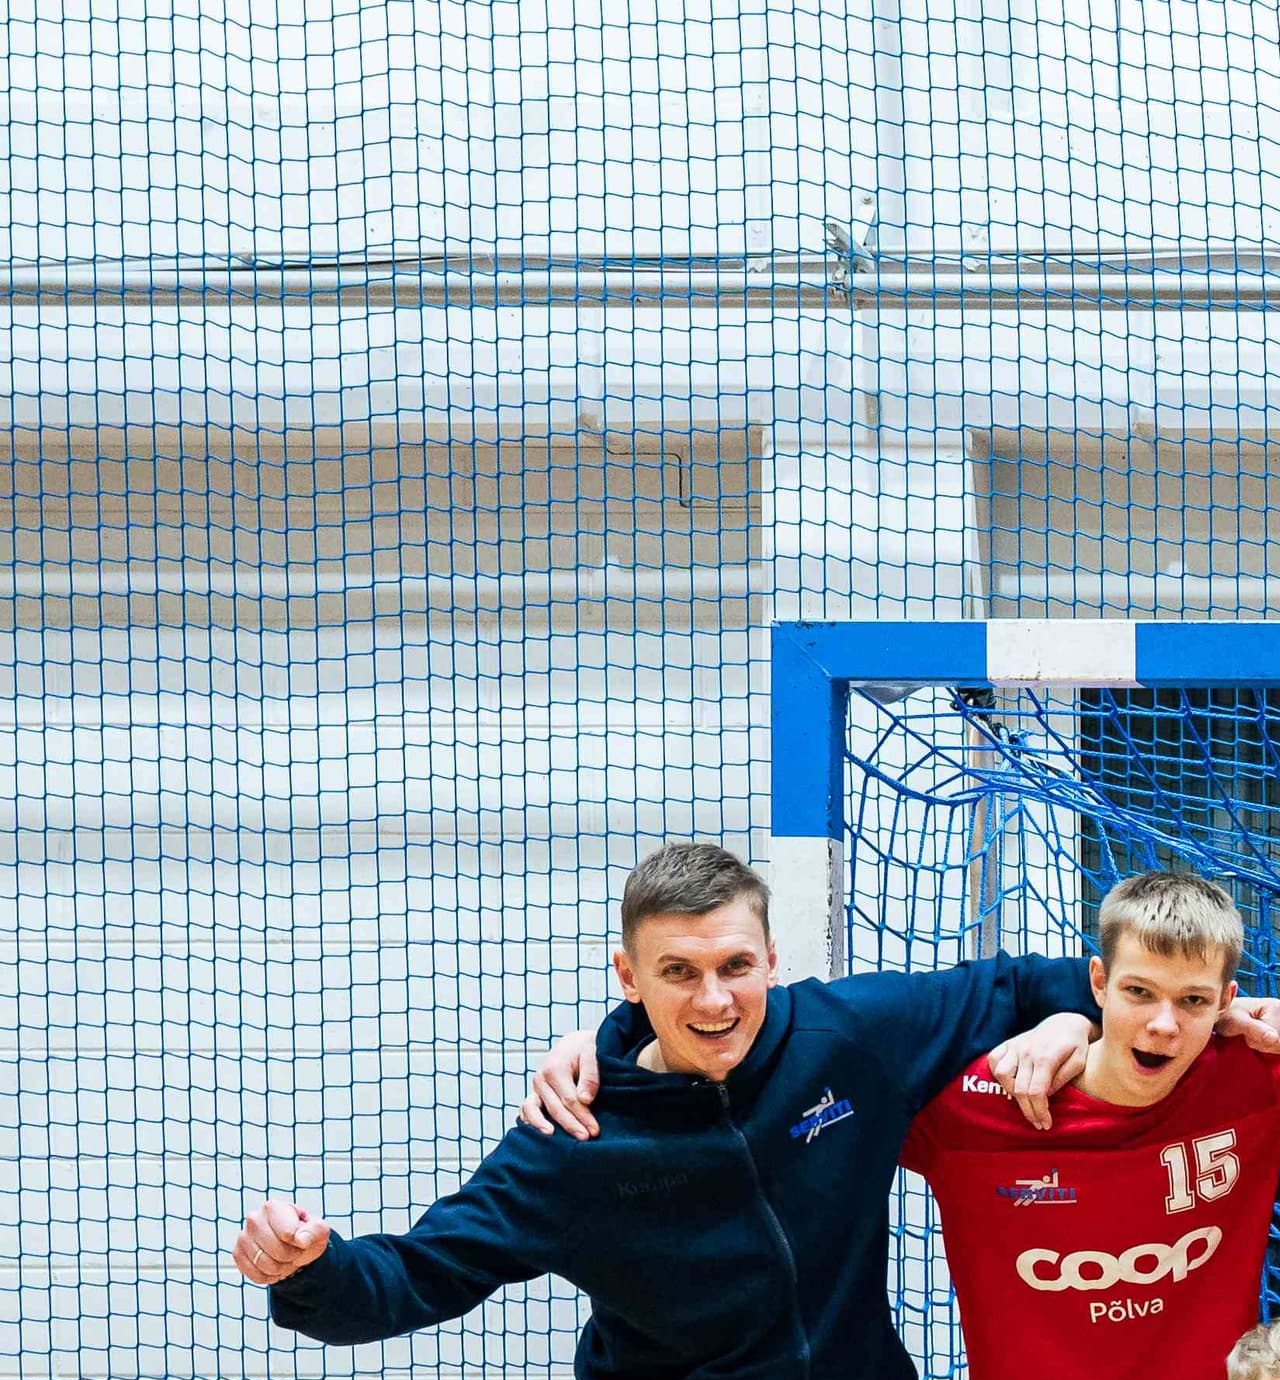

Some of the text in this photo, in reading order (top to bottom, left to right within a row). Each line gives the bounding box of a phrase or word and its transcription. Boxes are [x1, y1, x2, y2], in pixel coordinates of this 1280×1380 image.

[1159, 1128, 1241, 1215] 15
[1016, 1225, 1223, 1292] coop
[1089, 1297, 1164, 1323] Põlva
